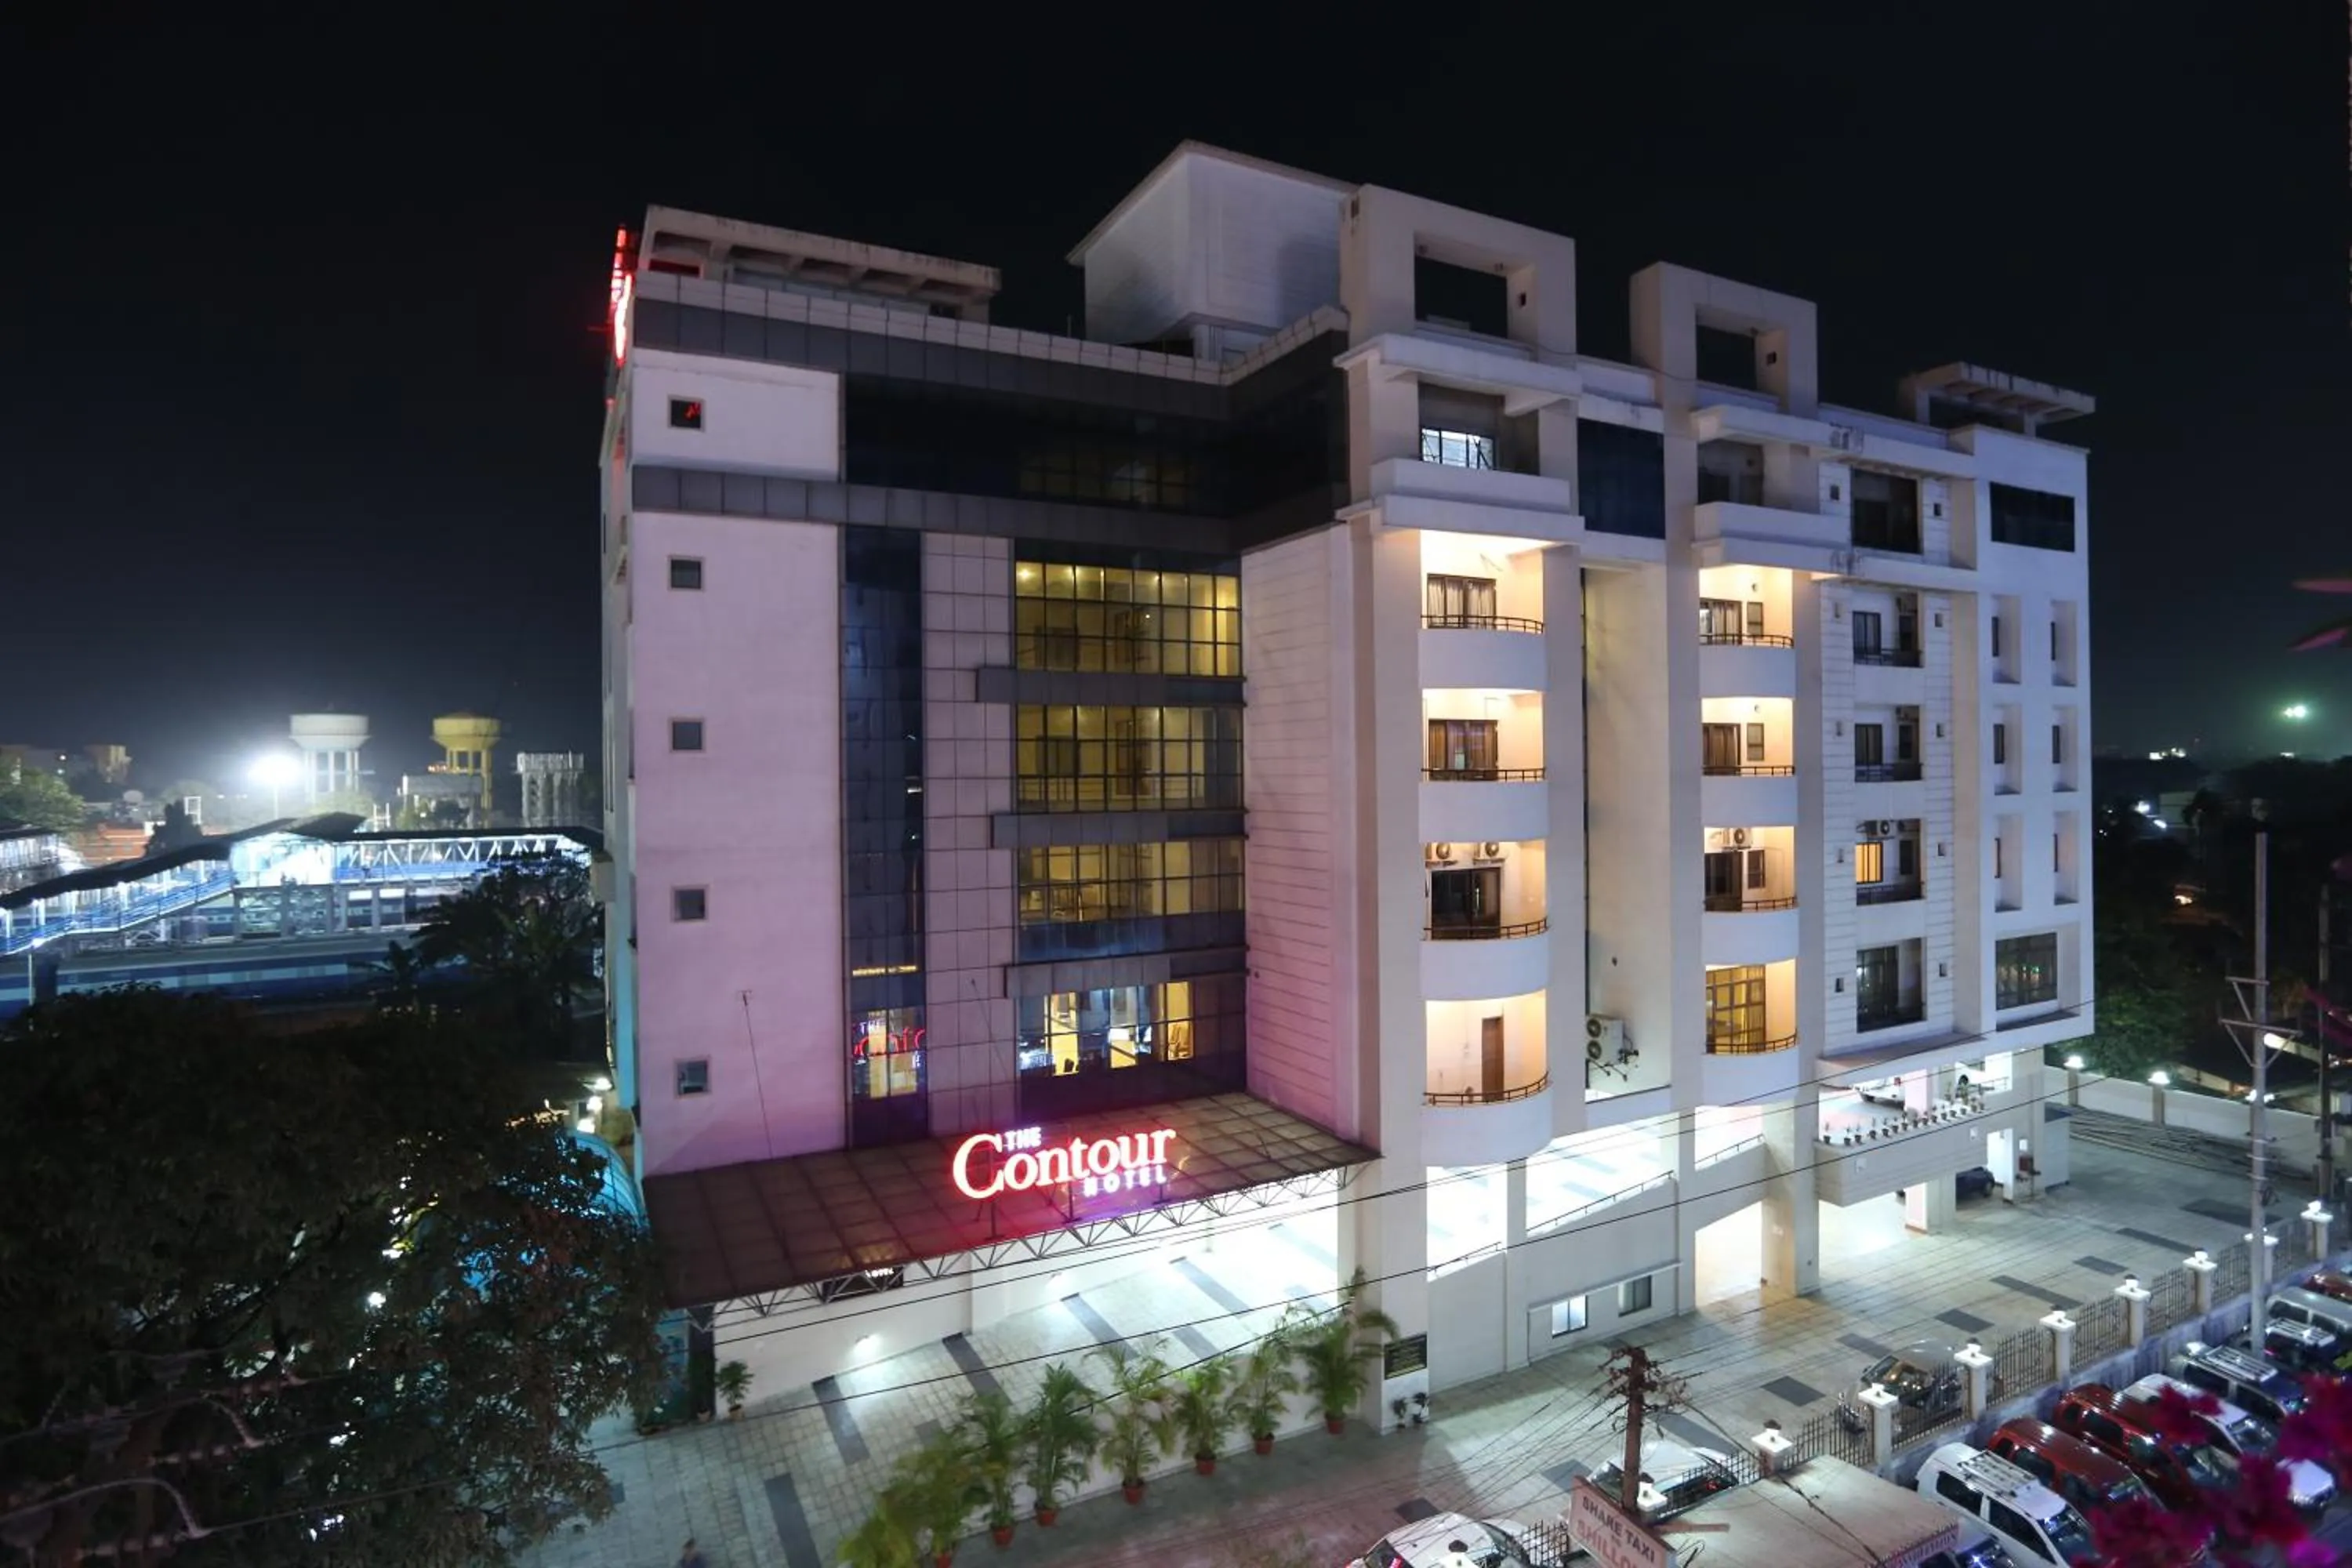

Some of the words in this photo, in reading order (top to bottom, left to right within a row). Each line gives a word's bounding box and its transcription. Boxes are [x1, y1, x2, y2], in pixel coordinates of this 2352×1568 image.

[1004, 1127, 1042, 1151] THE
[953, 1129, 1176, 1199] Contour
[1083, 1165, 1167, 1197] HOTEL
[1576, 1519, 1638, 1568] SHILLO
[1583, 1496, 1623, 1537] SHARE
[1625, 1529, 1655, 1563] TAXI
